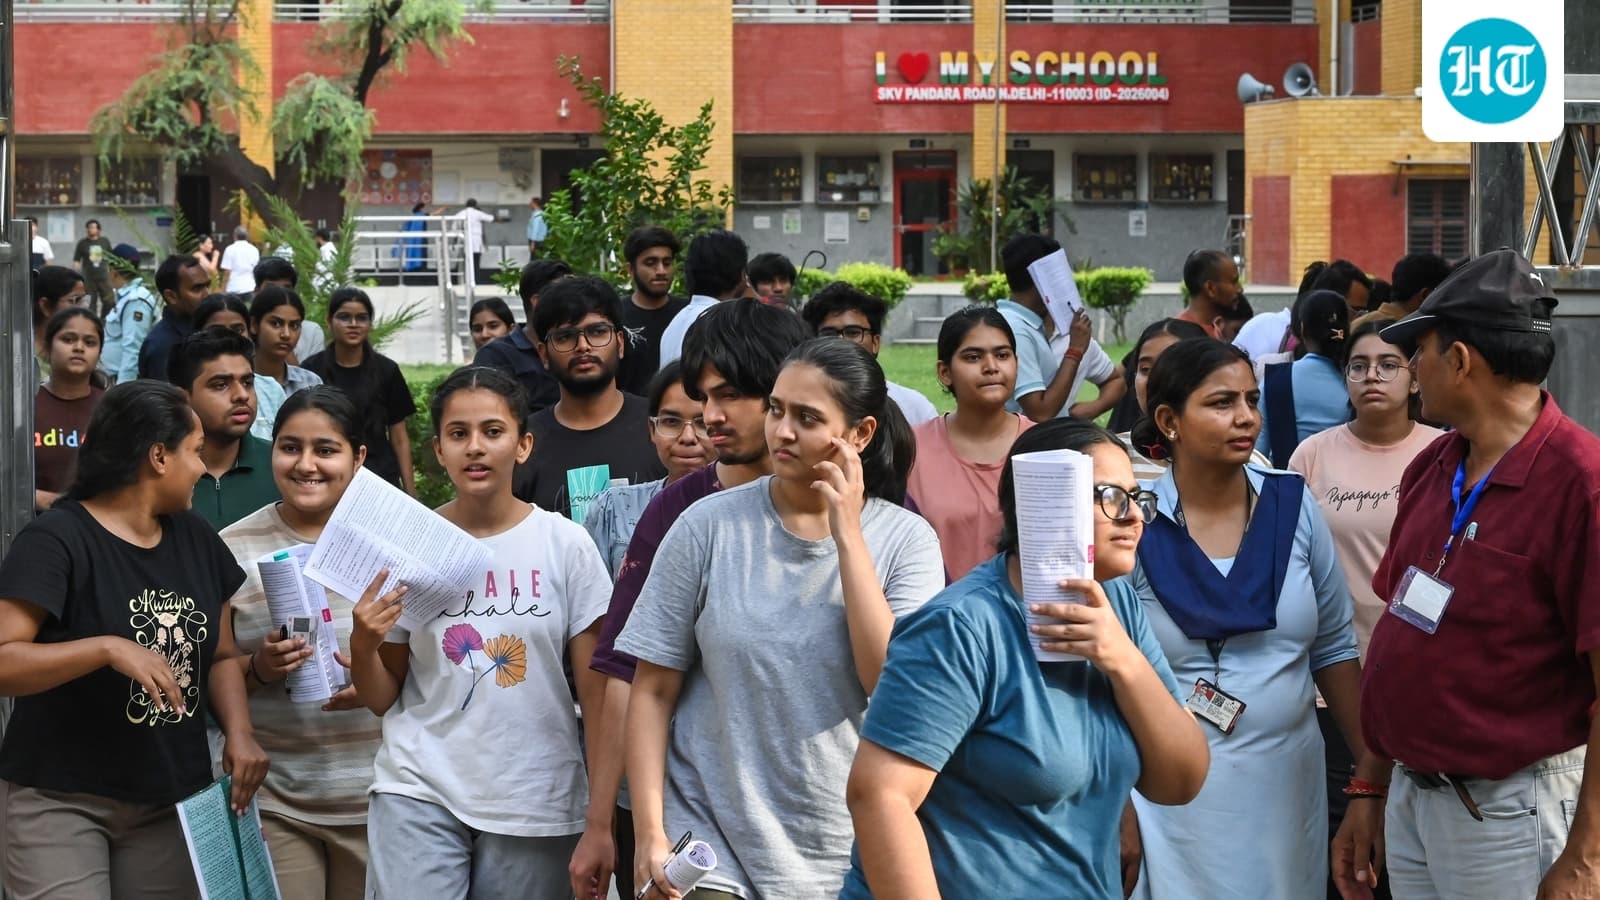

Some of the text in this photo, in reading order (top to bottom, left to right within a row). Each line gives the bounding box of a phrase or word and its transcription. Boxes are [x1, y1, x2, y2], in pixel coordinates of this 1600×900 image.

[875, 50, 1168, 85] I MY SCHOOL
[878, 87, 903, 100] SKV
[905, 87, 961, 100] PANDARA
[963, 87, 996, 100] ROAD
[1326, 486, 1390, 512] Papagayo
[129, 588, 195, 620] Always
